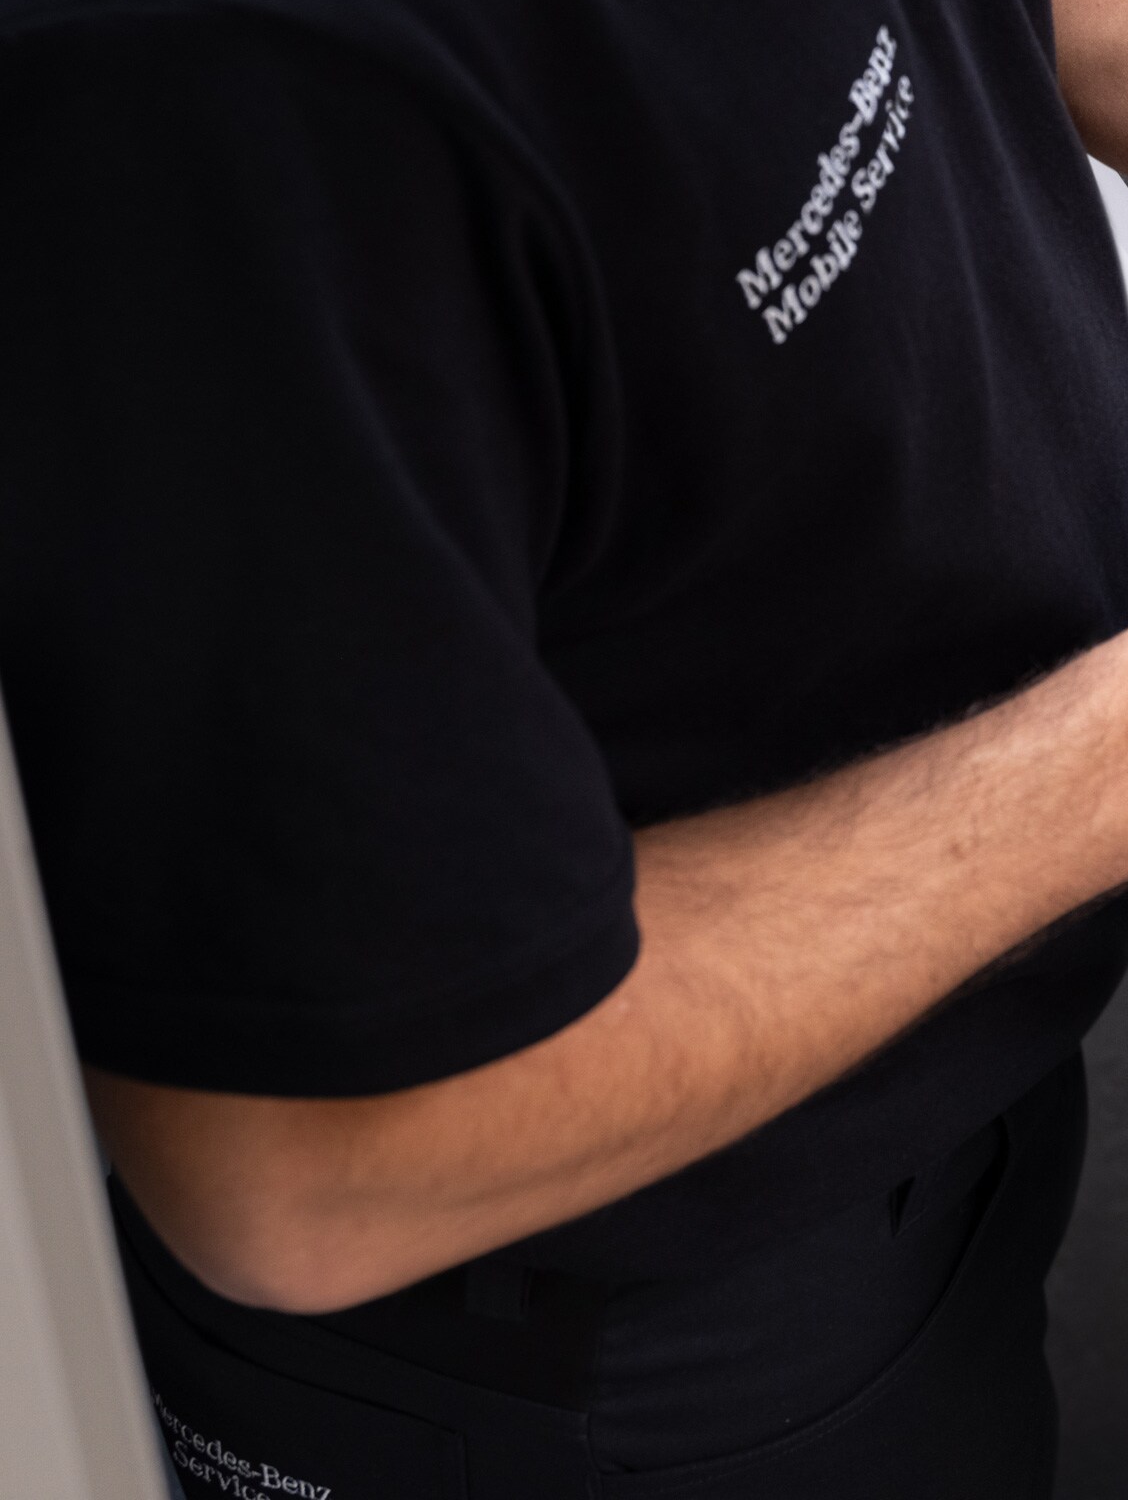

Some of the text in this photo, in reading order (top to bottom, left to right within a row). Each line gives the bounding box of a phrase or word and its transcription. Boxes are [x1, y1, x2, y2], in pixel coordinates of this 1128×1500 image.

[737, 24, 897, 310] Mercedes-Benz
[761, 74, 915, 345] Mobile Service
[173, 1440, 272, 1500] Service
